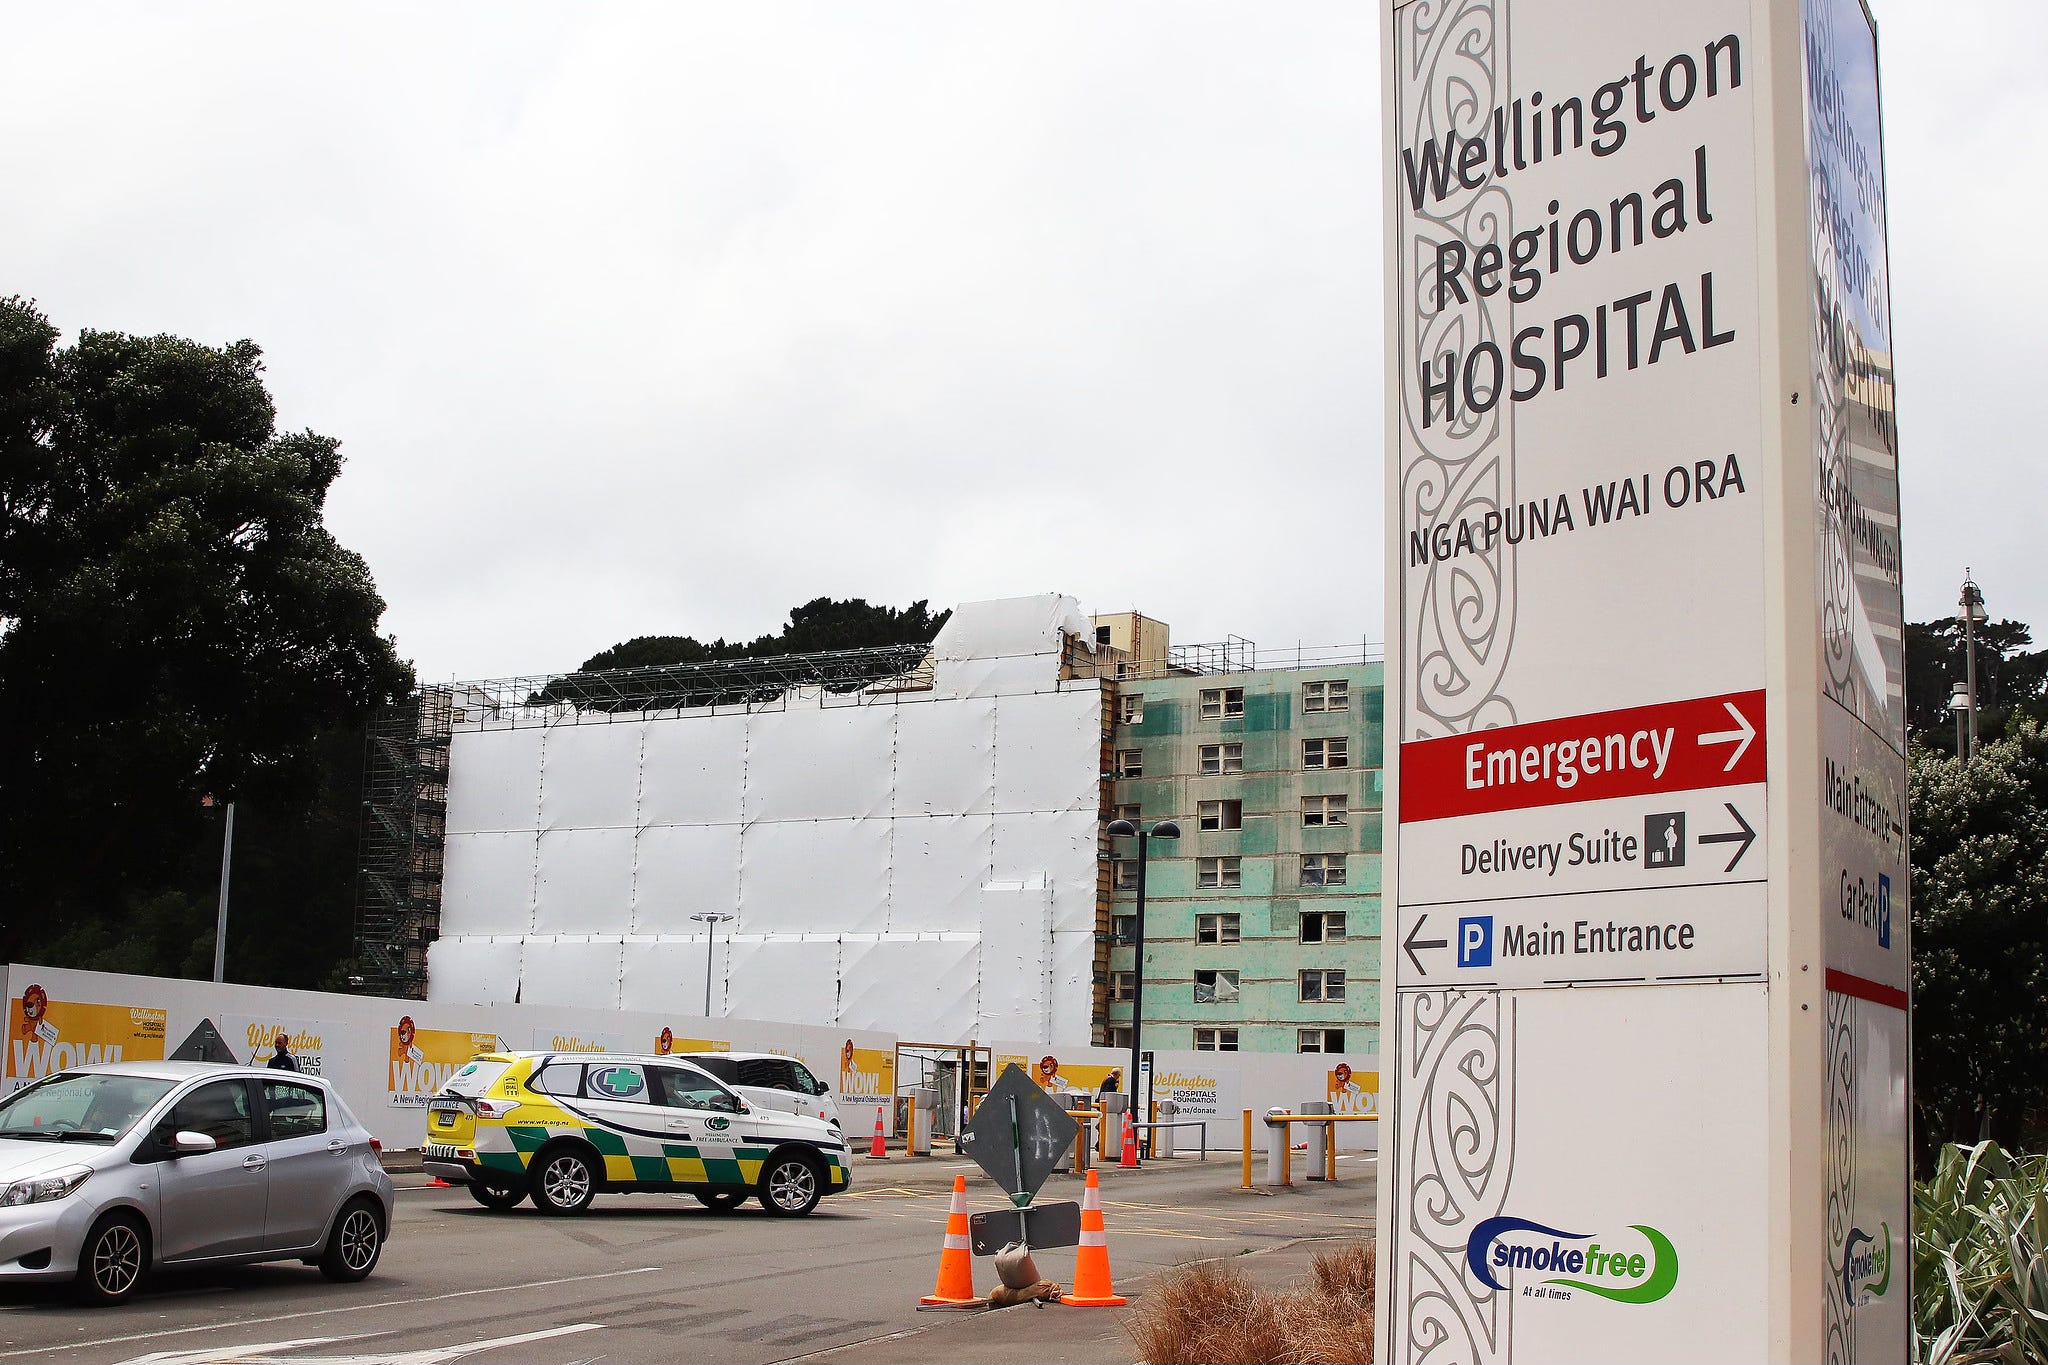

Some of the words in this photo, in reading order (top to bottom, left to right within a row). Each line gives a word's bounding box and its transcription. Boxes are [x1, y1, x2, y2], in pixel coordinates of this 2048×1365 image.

[1403, 33, 1741, 211] Wellington
[1807, 31, 1883, 240] Wellington
[1436, 144, 1713, 312] Regional
[1818, 158, 1885, 342] Regional
[1422, 271, 1735, 429] HOSPITAL
[1410, 518, 1475, 567] NGA
[1484, 494, 1575, 550] PUNA
[1582, 473, 1650, 528] WAI
[1663, 453, 1746, 509] ORA
[1465, 727, 1675, 790] Emergency
[1825, 756, 1852, 820] Main
[1854, 776, 1890, 844] Entrance
[1461, 838, 1562, 877] Delivery
[1568, 828, 1638, 866] Suite
[1840, 868, 1857, 924] Car
[1858, 876, 1878, 931] Park
[1463, 923, 1484, 962] P
[1502, 921, 1565, 957] Main
[1574, 920, 1695, 955] Entrance
[247, 1023, 323, 1055] Wellngton
[392, 1061, 463, 1091] WOW
[842, 1071, 879, 1094] WOW!
[1173, 1090, 1217, 1098] HOSPITALS
[399, 1095, 414, 1104] New
[414, 1095, 431, 1106] Regio
[517, 1119, 569, 1127] www.wfa.org.nz
[1492, 1241, 1646, 1278] smokefree
[1850, 1244, 1885, 1282] smokefree
[1522, 1285, 1533, 1297] At
[1534, 1287, 1546, 1299] all
[1548, 1288, 1572, 1301] times
